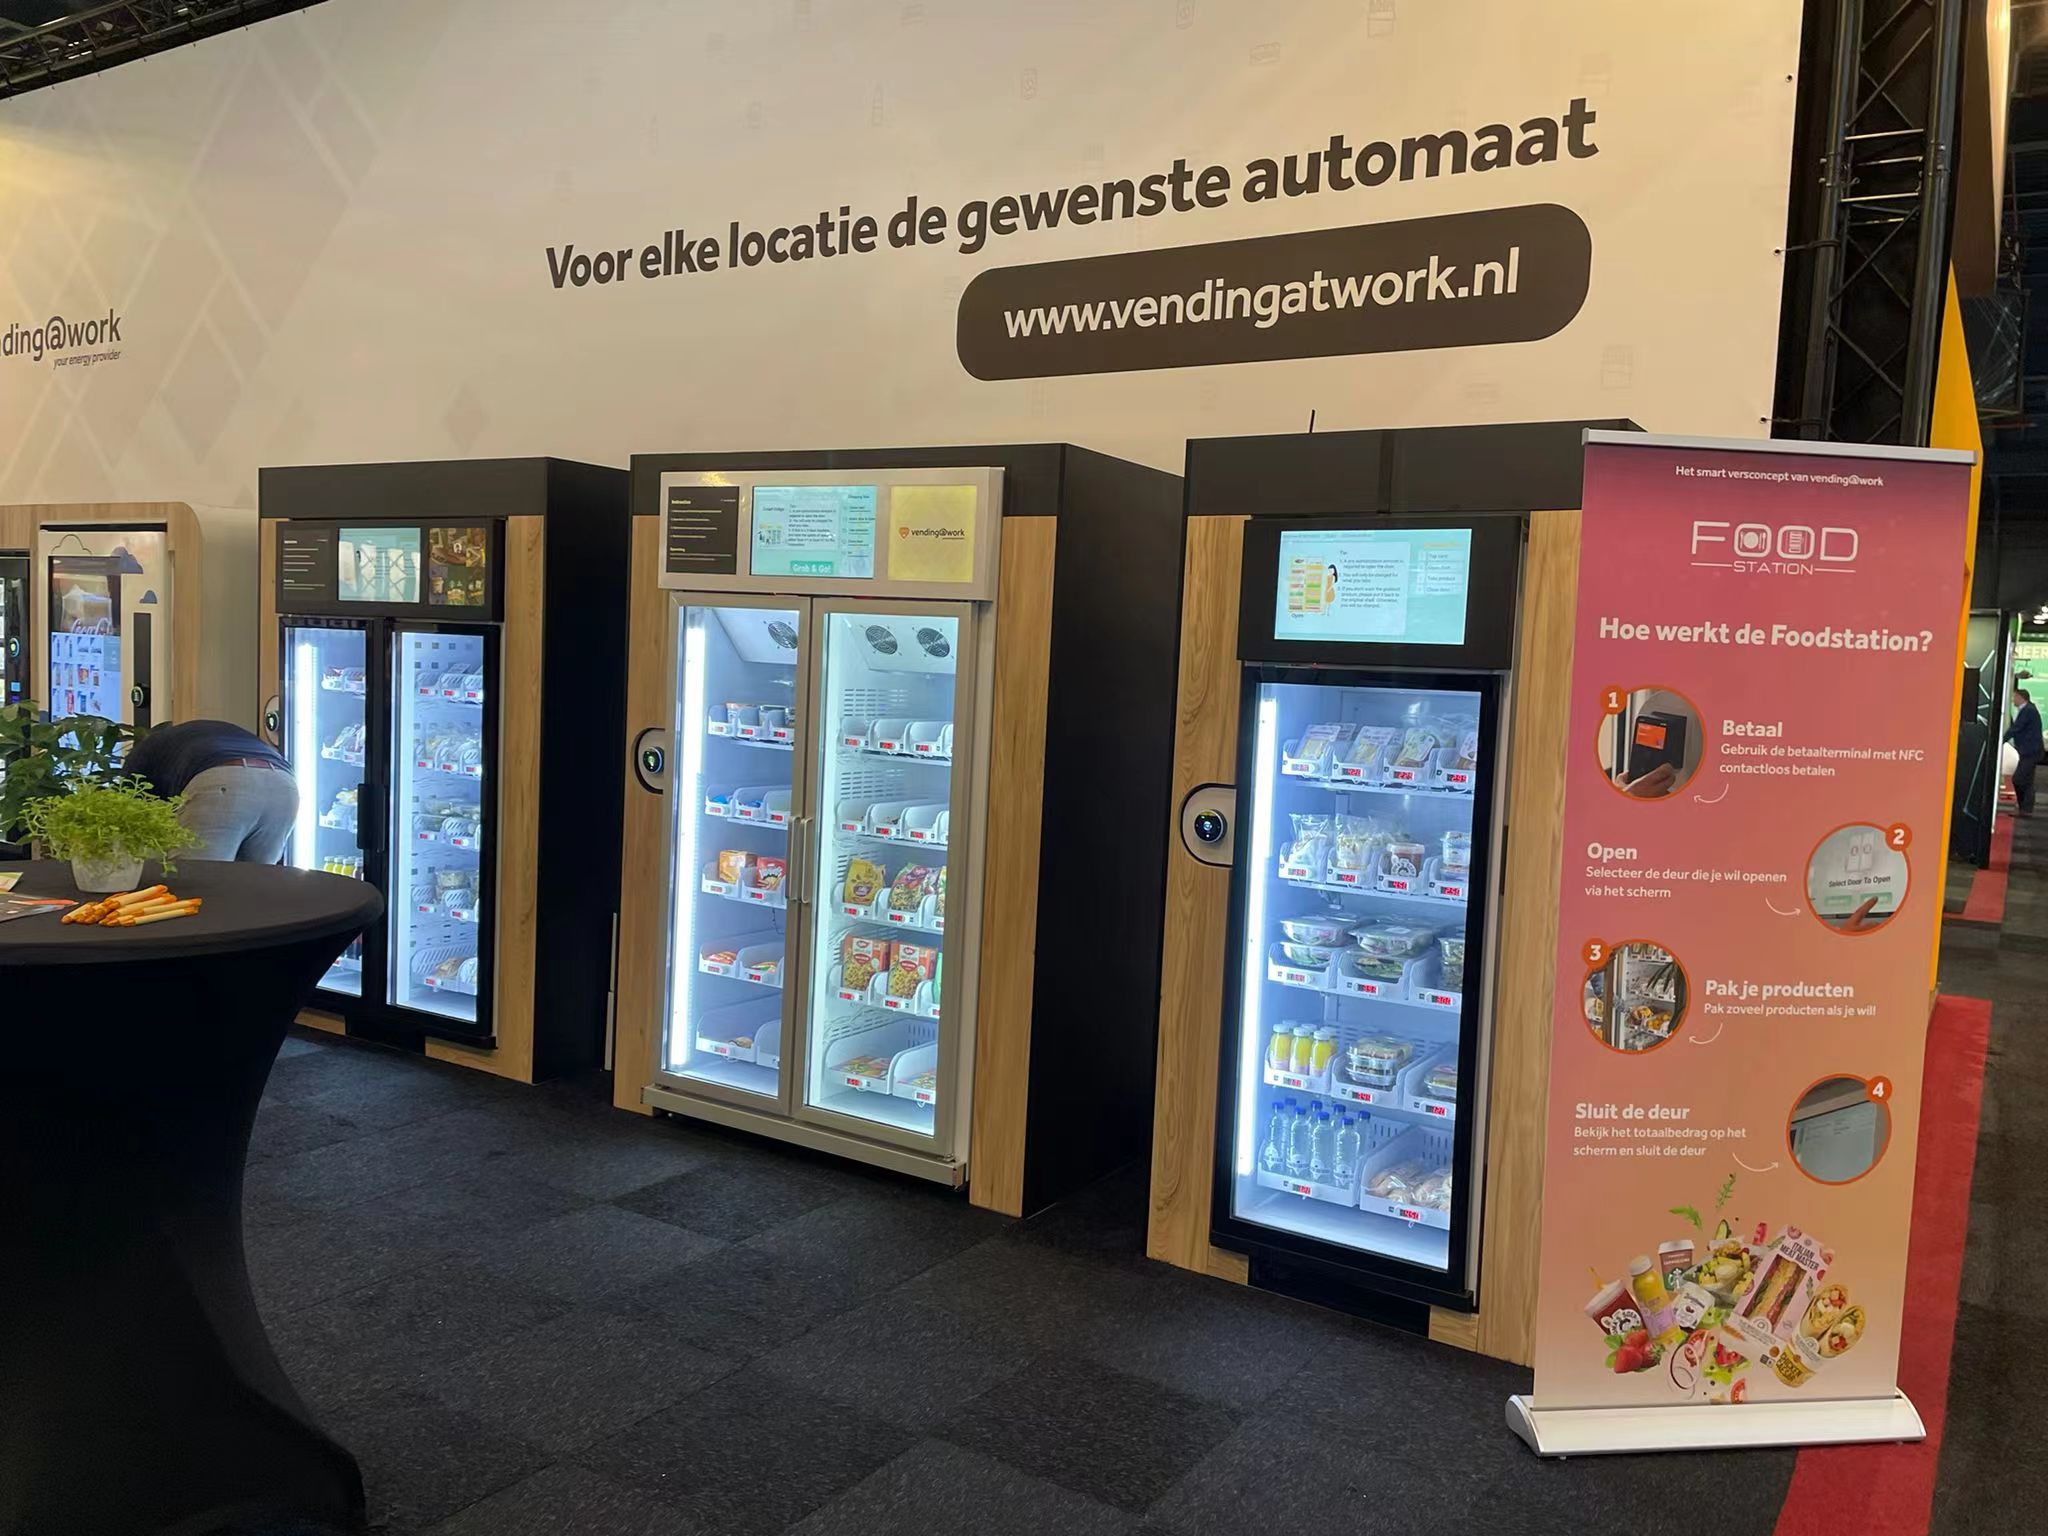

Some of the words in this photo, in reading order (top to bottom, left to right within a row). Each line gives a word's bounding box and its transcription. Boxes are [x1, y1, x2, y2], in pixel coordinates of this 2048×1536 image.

[546, 245, 633, 289] Voor
[640, 230, 720, 279] elke
[729, 205, 877, 267] locatie
[888, 196, 947, 249] de
[957, 159, 1231, 254] gewenste
[1242, 97, 1599, 204] automaat
[1004, 247, 1520, 338] www.vendingatwork.nl
[0, 308, 121, 361] ding@work
[53, 355, 69, 370] your
[69, 352, 91, 367] energy
[92, 349, 121, 364] provider
[1676, 466, 1694, 478] Het
[1696, 468, 1726, 478] smart
[1728, 470, 1789, 484] versconcept
[1790, 473, 1809, 483] van
[1810, 472, 1884, 487] vending@work
[911, 528, 965, 538] vending@work
[1691, 520, 1859, 562] FOOD
[1733, 561, 1814, 576] STATION
[1599, 617, 1650, 641] Hoe
[1655, 620, 1729, 645] werkt
[1734, 623, 1765, 646] de
[1771, 624, 1933, 652] Foodstation?
[1607, 692, 1619, 708] 1
[1722, 719, 1783, 738] Betaal
[1721, 743, 1767, 756] Gebruik
[1769, 745, 1785, 757] de
[1787, 745, 1871, 760] betaalterminal
[1873, 748, 1897, 760] met
[1899, 749, 1924, 761] NFC
[1719, 762, 1790, 776] contactloos
[1792, 763, 1835, 776] betalen
[1893, 829, 1905, 845] 2
[1587, 842, 1637, 861] Open
[1586, 866, 1643, 879] Selecteer
[1644, 867, 1660, 879] de
[1662, 868, 1691, 880] deur
[1693, 869, 1710, 881] die
[1711, 869, 1721, 883] je
[1723, 870, 1740, 881] wil
[1742, 872, 1787, 885] openen
[1873, 876, 1890, 884] Open
[1585, 885, 1602, 896] via
[1604, 884, 1624, 897] het
[1626, 885, 1671, 898] scherm
[1589, 945, 1601, 960] 3
[1705, 980, 1738, 997] Pak
[1740, 980, 1758, 1000] je
[1762, 982, 1854, 1000] producten
[1704, 1003, 1724, 1014] Pak
[1726, 1004, 1764, 1015] zoveel
[1766, 1005, 1825, 1018] producten
[1827, 1004, 1842, 1016] als
[1843, 1004, 1857, 1018] je
[1872, 1082, 1884, 1097] 4
[1575, 1103, 1618, 1120] Sluit
[1622, 1103, 1646, 1120] de
[1648, 1105, 1690, 1120] deur
[1574, 1126, 1609, 1140] Bekijk
[1611, 1126, 1631, 1138] het
[1634, 1127, 1708, 1141] totaalbedrag
[1710, 1129, 1725, 1141] op
[1727, 1126, 1746, 1138] het
[1573, 1145, 1617, 1156] scherm
[1619, 1147, 1634, 1156] en
[1636, 1145, 1659, 1156] sluit
[1661, 1145, 1676, 1156] de
[1678, 1145, 1707, 1156] deur
